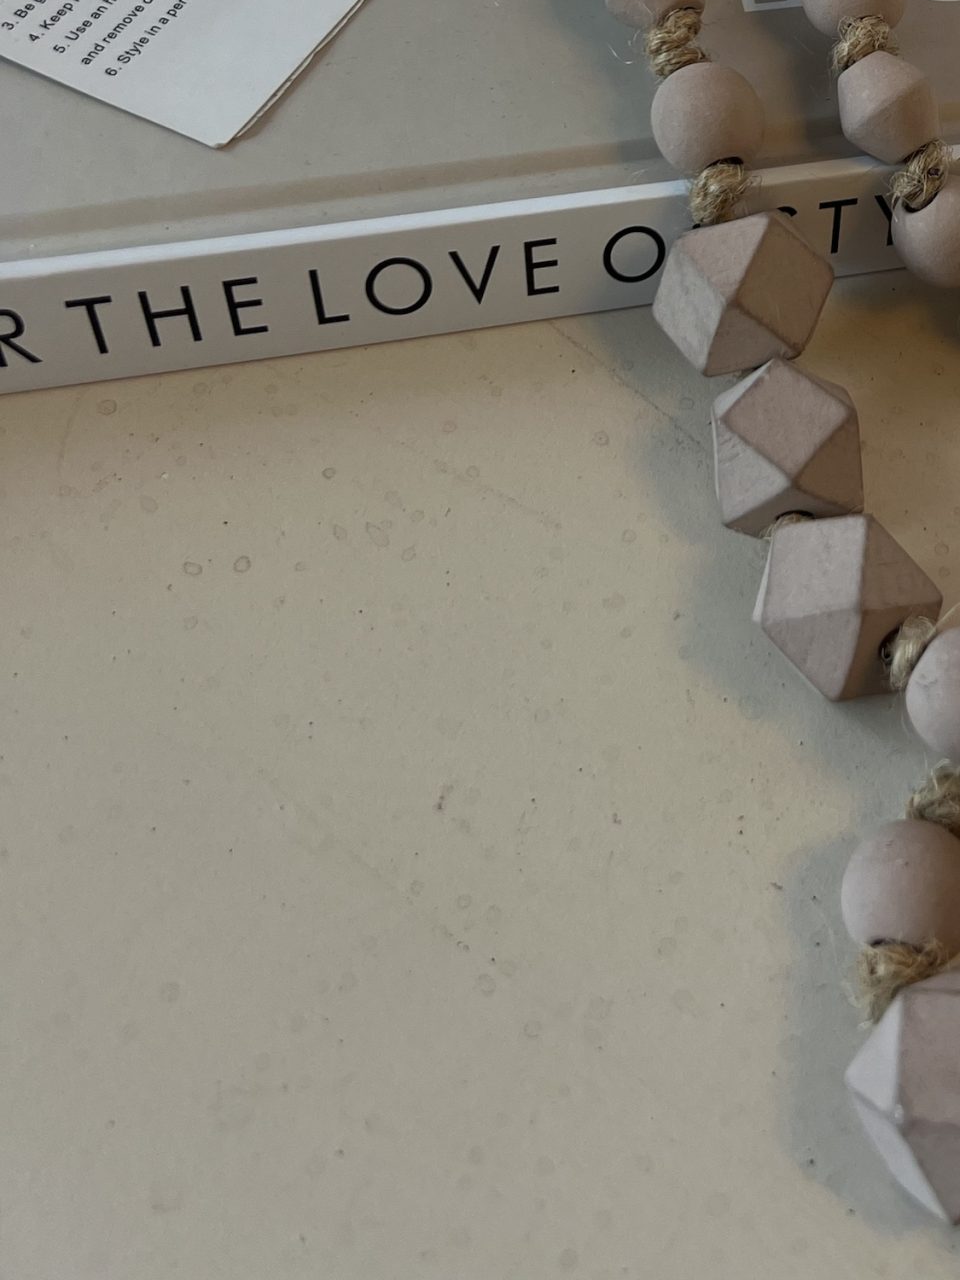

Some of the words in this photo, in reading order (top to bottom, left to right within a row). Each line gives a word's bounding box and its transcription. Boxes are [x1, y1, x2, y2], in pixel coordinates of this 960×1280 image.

[1, 20, 19, 31] 3.
[14, 3, 35, 19] Be
[28, 32, 45, 42] 4.
[39, 2, 74, 30] Keep
[53, 44, 70, 54] 5.
[64, 19, 93, 41] Use
[90, 5, 109, 20] an
[81, 43, 105, 65] and
[102, 4, 145, 44] remove
[104, 66, 123, 77] 6.
[117, 36, 150, 64] Style
[144, 25, 162, 36] in
[158, 16, 170, 25] a
[64, 276, 269, 355] THE
[308, 237, 560, 326] LOVE
[602, 223, 702, 283] O
